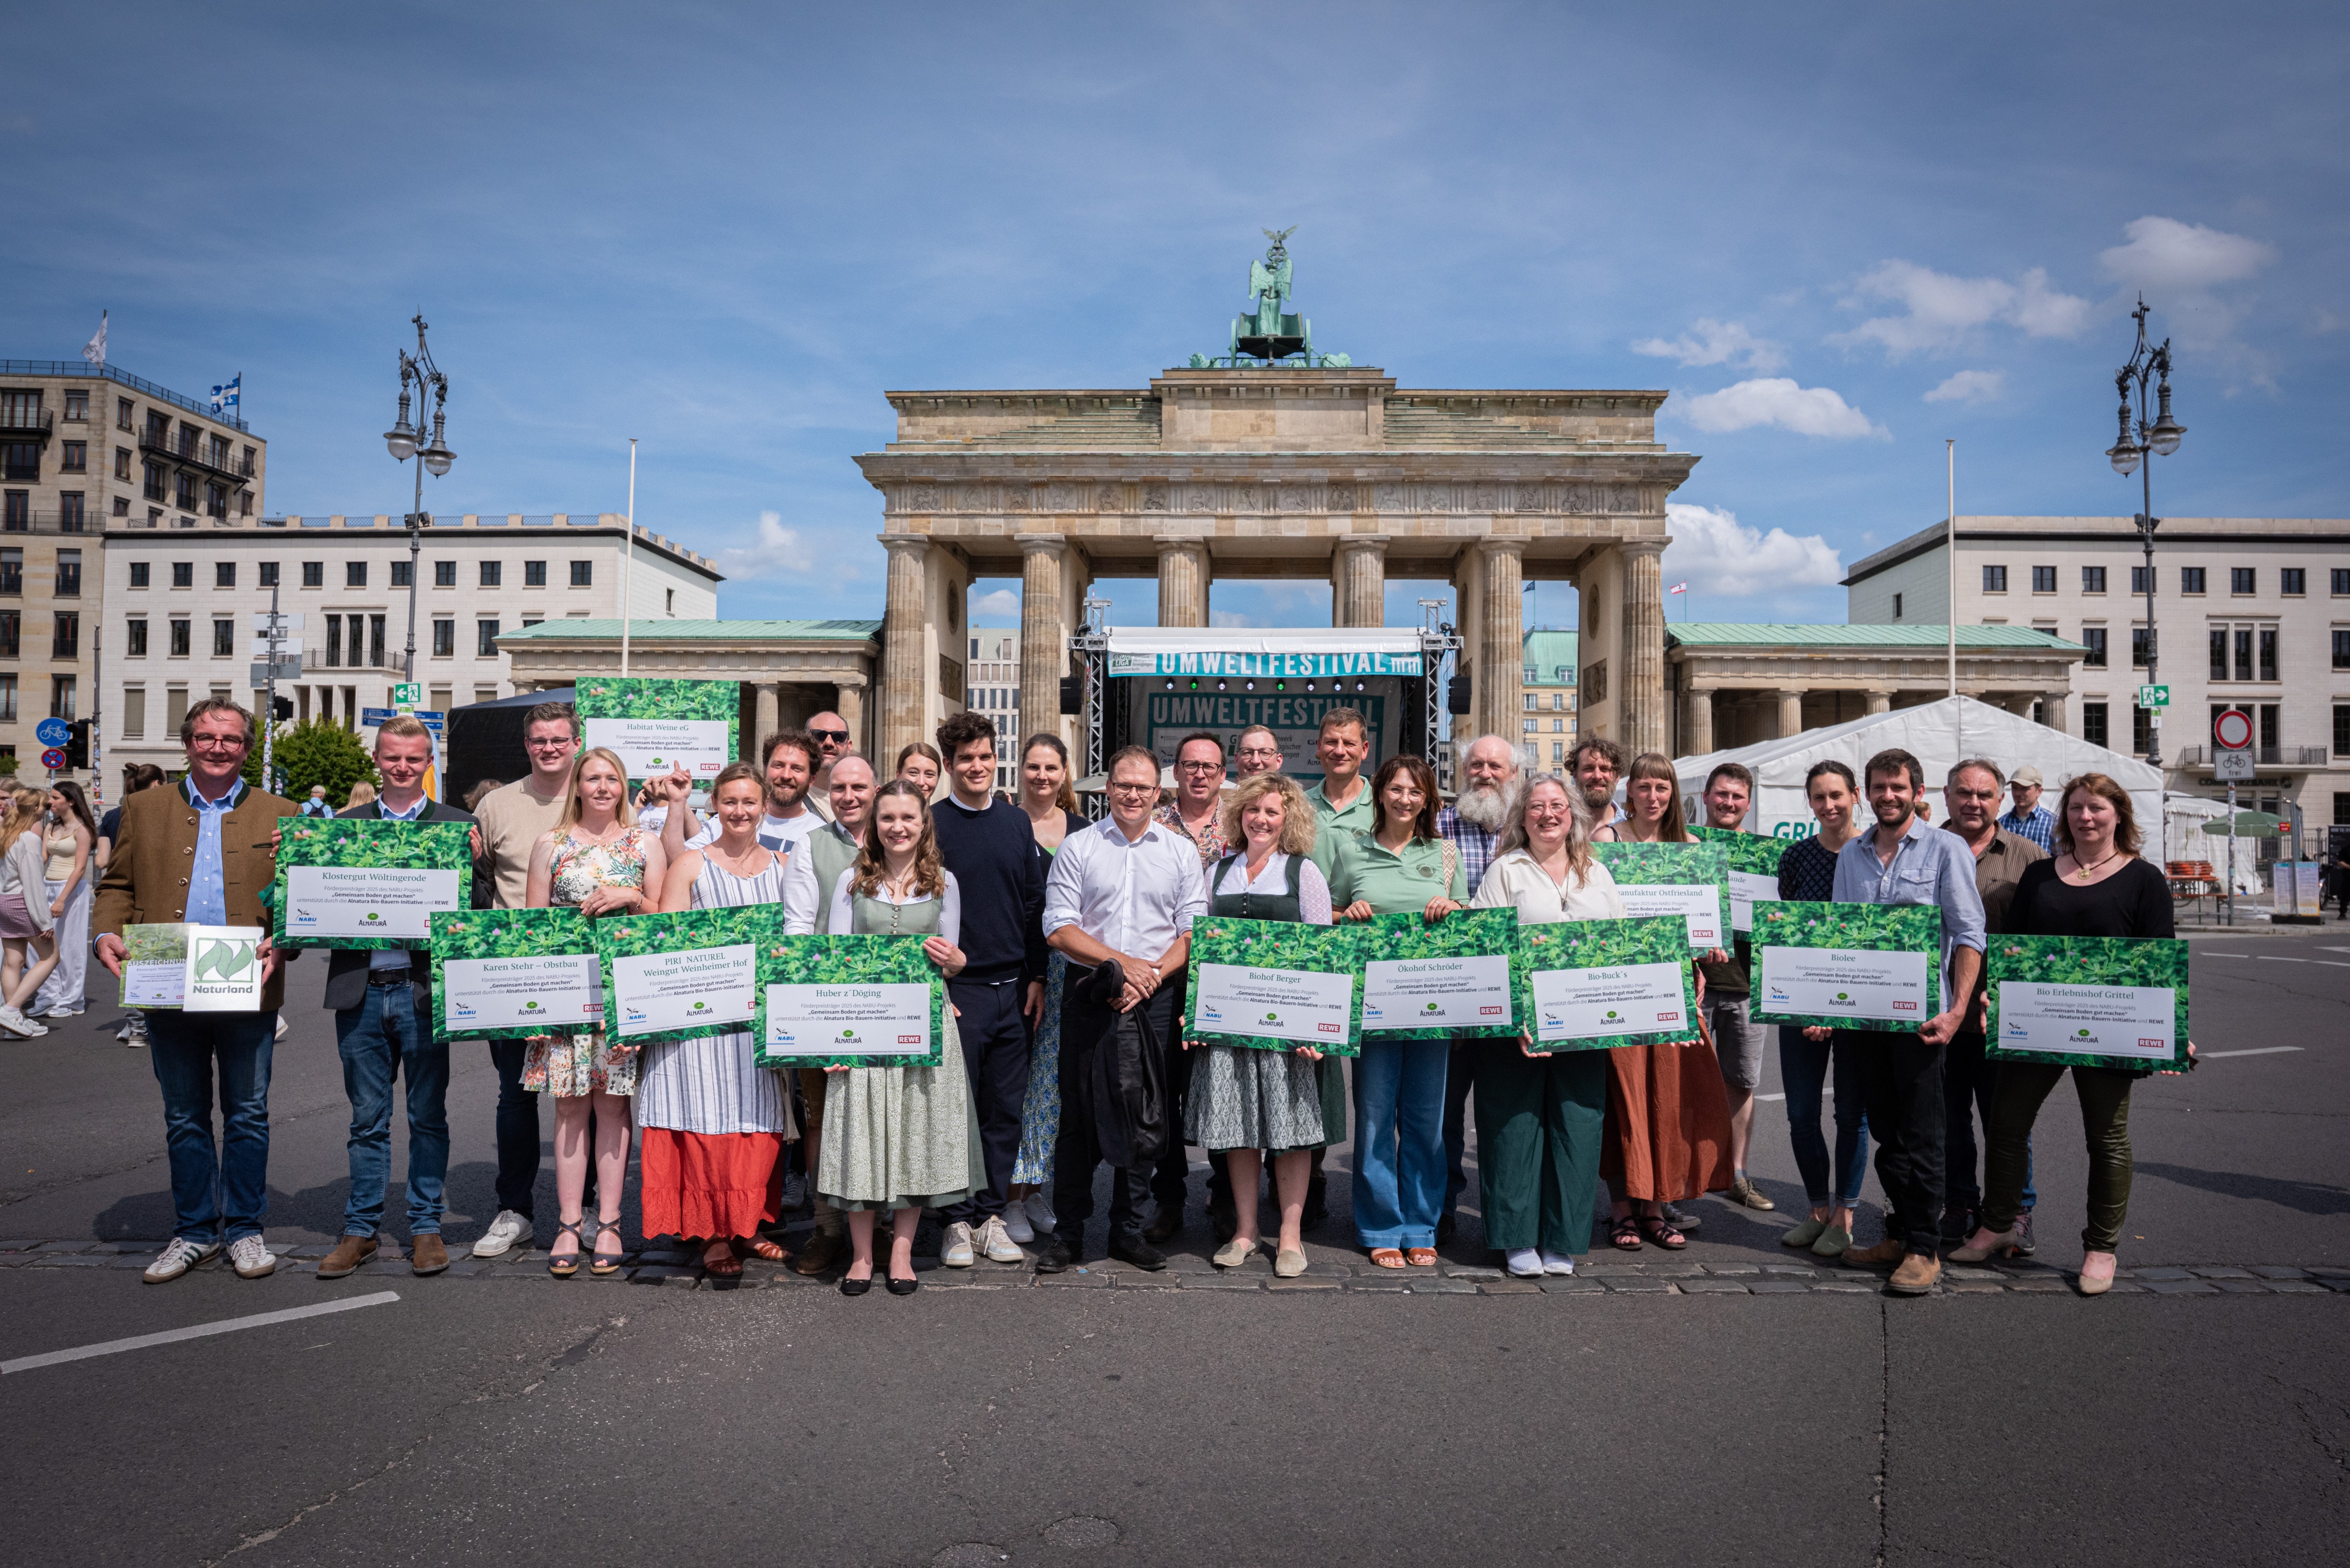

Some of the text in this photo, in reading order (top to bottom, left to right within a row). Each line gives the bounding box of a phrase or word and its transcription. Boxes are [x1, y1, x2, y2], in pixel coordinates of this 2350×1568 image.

[1161, 653, 1386, 675] UMWELTFESTIVAL
[322, 872, 426, 883] Klostergut Wöltingerode
[665, 952, 726, 965] PIRI NATUREL
[543, 960, 578, 969] Obstbau
[643, 959, 748, 977] Weingut Weinheimer Hof
[1397, 962, 1463, 973] Ökohof Schröder
[1249, 972, 1301, 984] Biohof Berger
[2053, 988, 2104, 998] Erlebnishof
[2105, 991, 2134, 999] Grittel
[1829, 998, 1856, 1007] ALNATURA
[686, 1008, 713, 1017] ALNATURA
[1258, 1019, 1284, 1028] ALNATURA
[2070, 1035, 2098, 1044] ALNATURA
